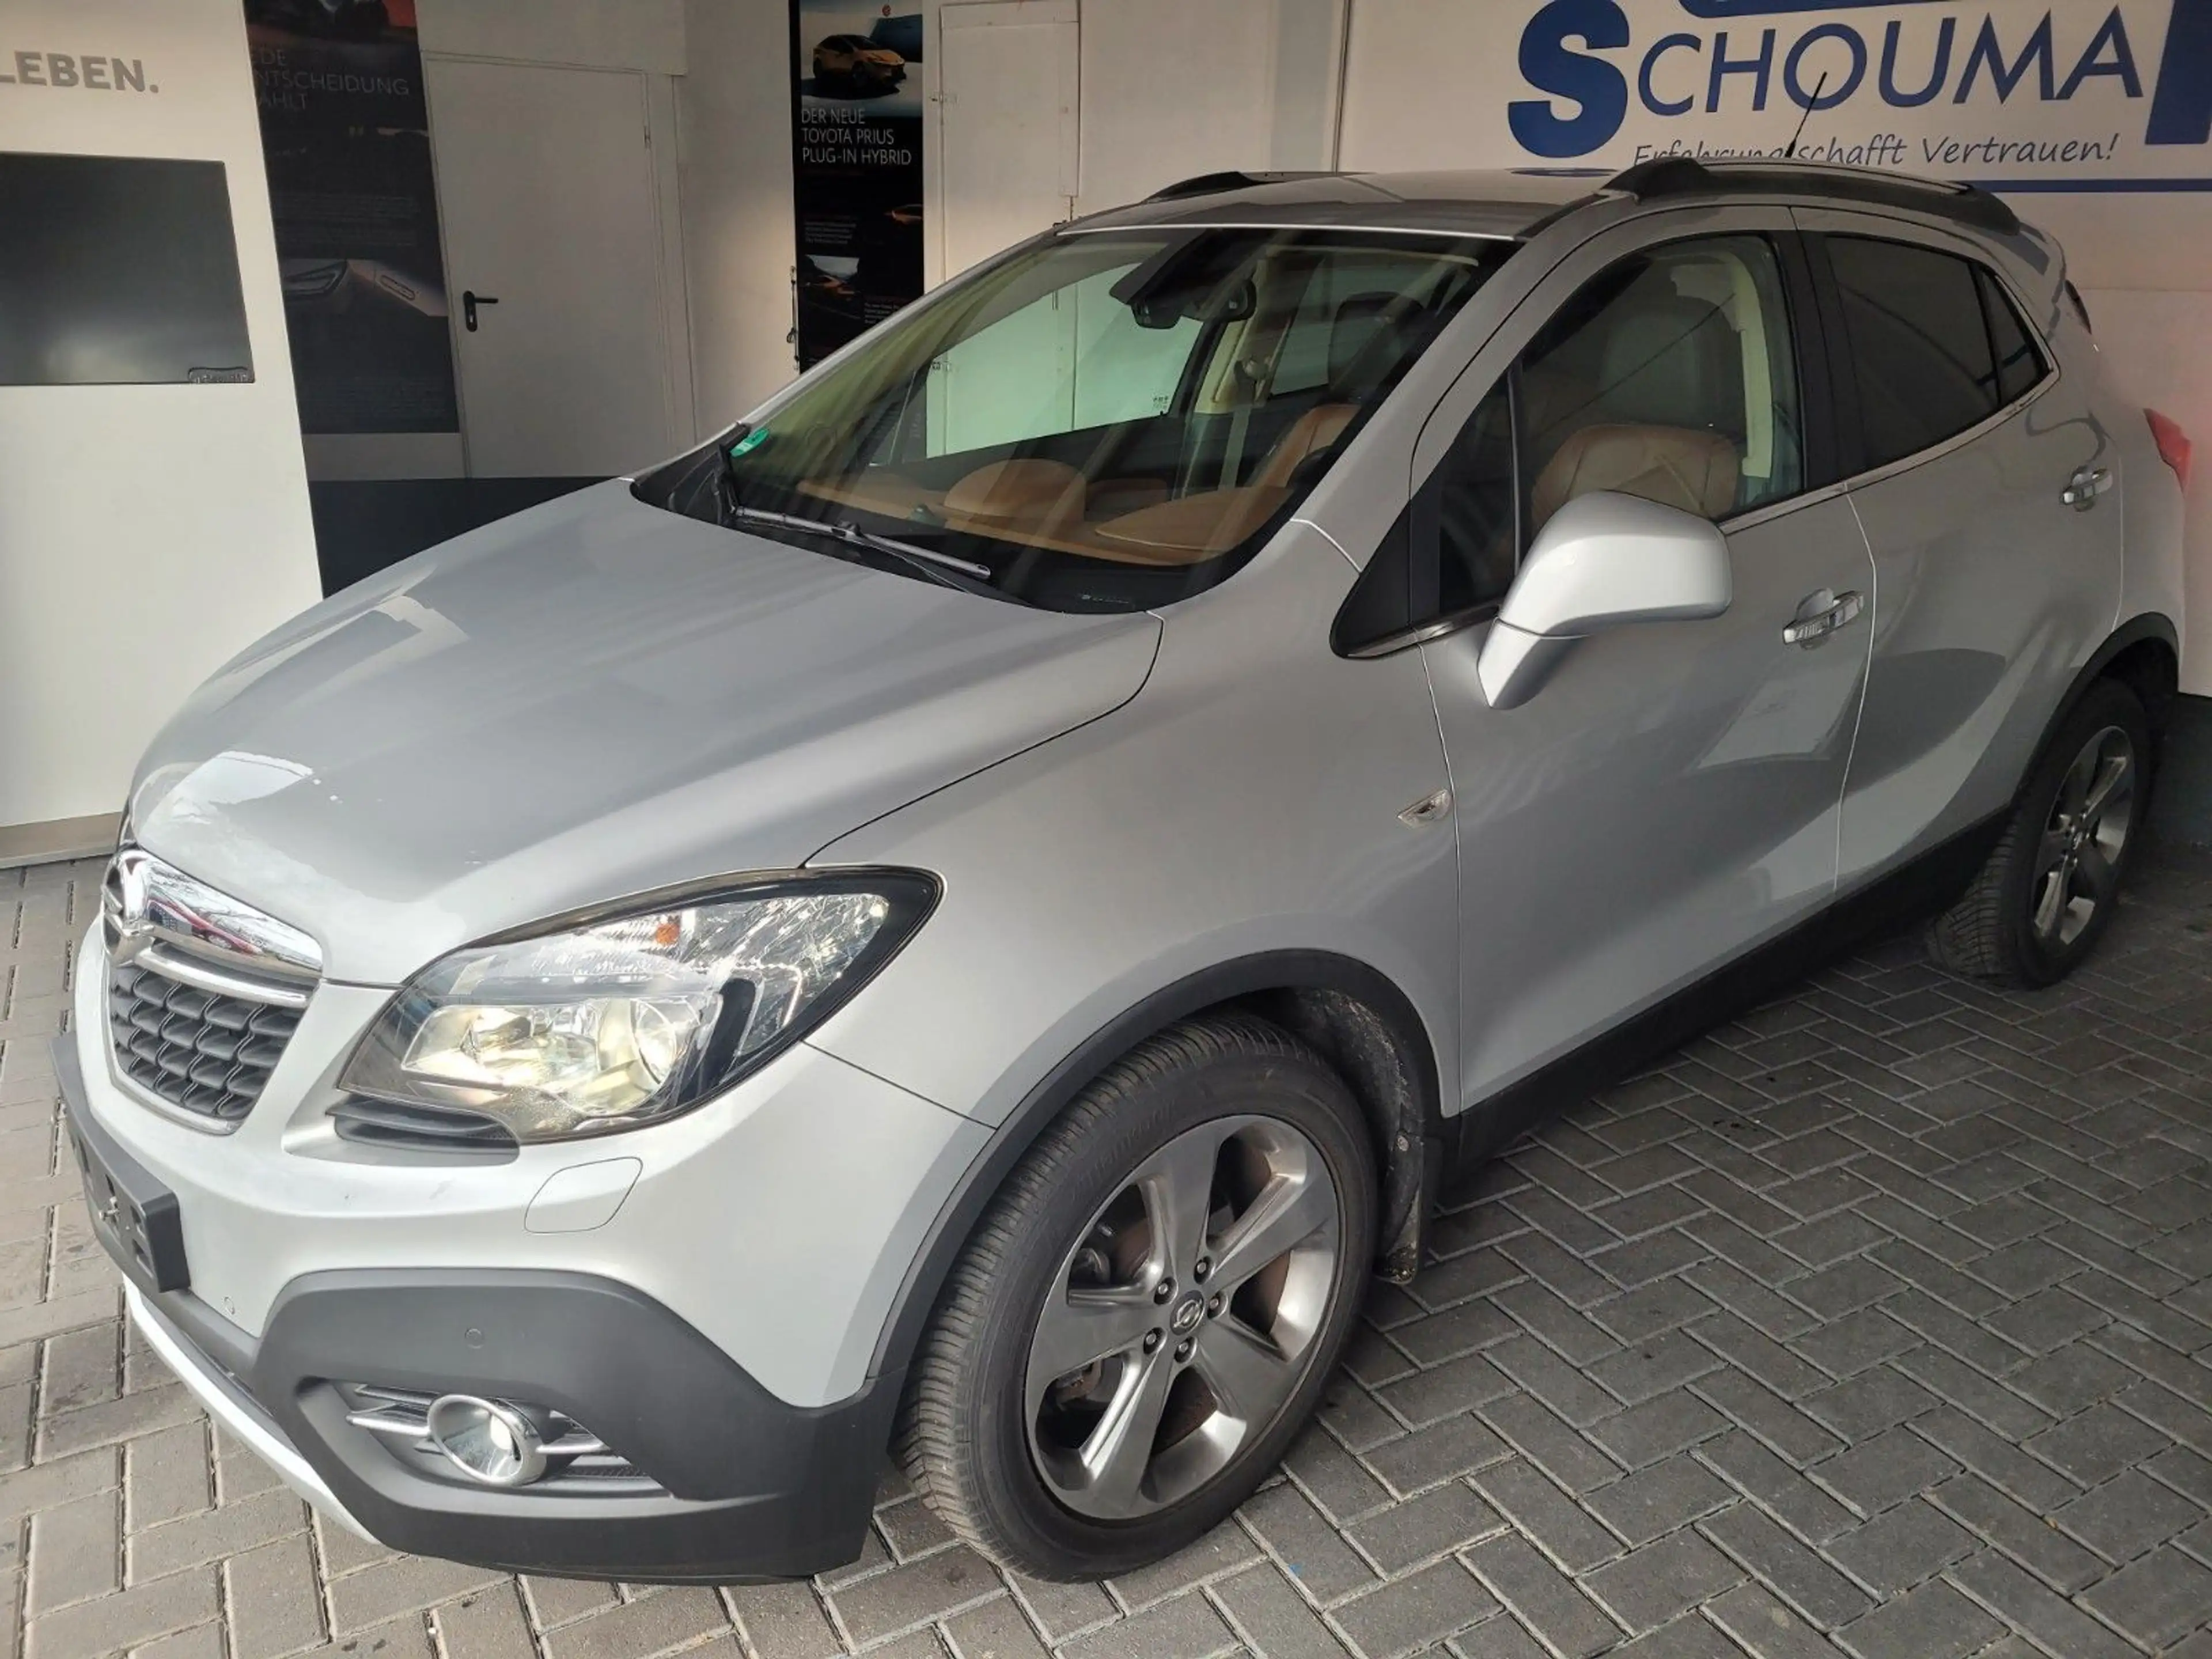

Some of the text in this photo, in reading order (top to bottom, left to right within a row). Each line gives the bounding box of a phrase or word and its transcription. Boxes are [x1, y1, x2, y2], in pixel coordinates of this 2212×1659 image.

[801, 108, 866, 125] DER NEUE
[801, 127, 895, 145] TOYOTA PRIUS
[802, 147, 912, 166] PLUG-IN HYBRID
[1922, 132, 2120, 164] Vertrauen!
